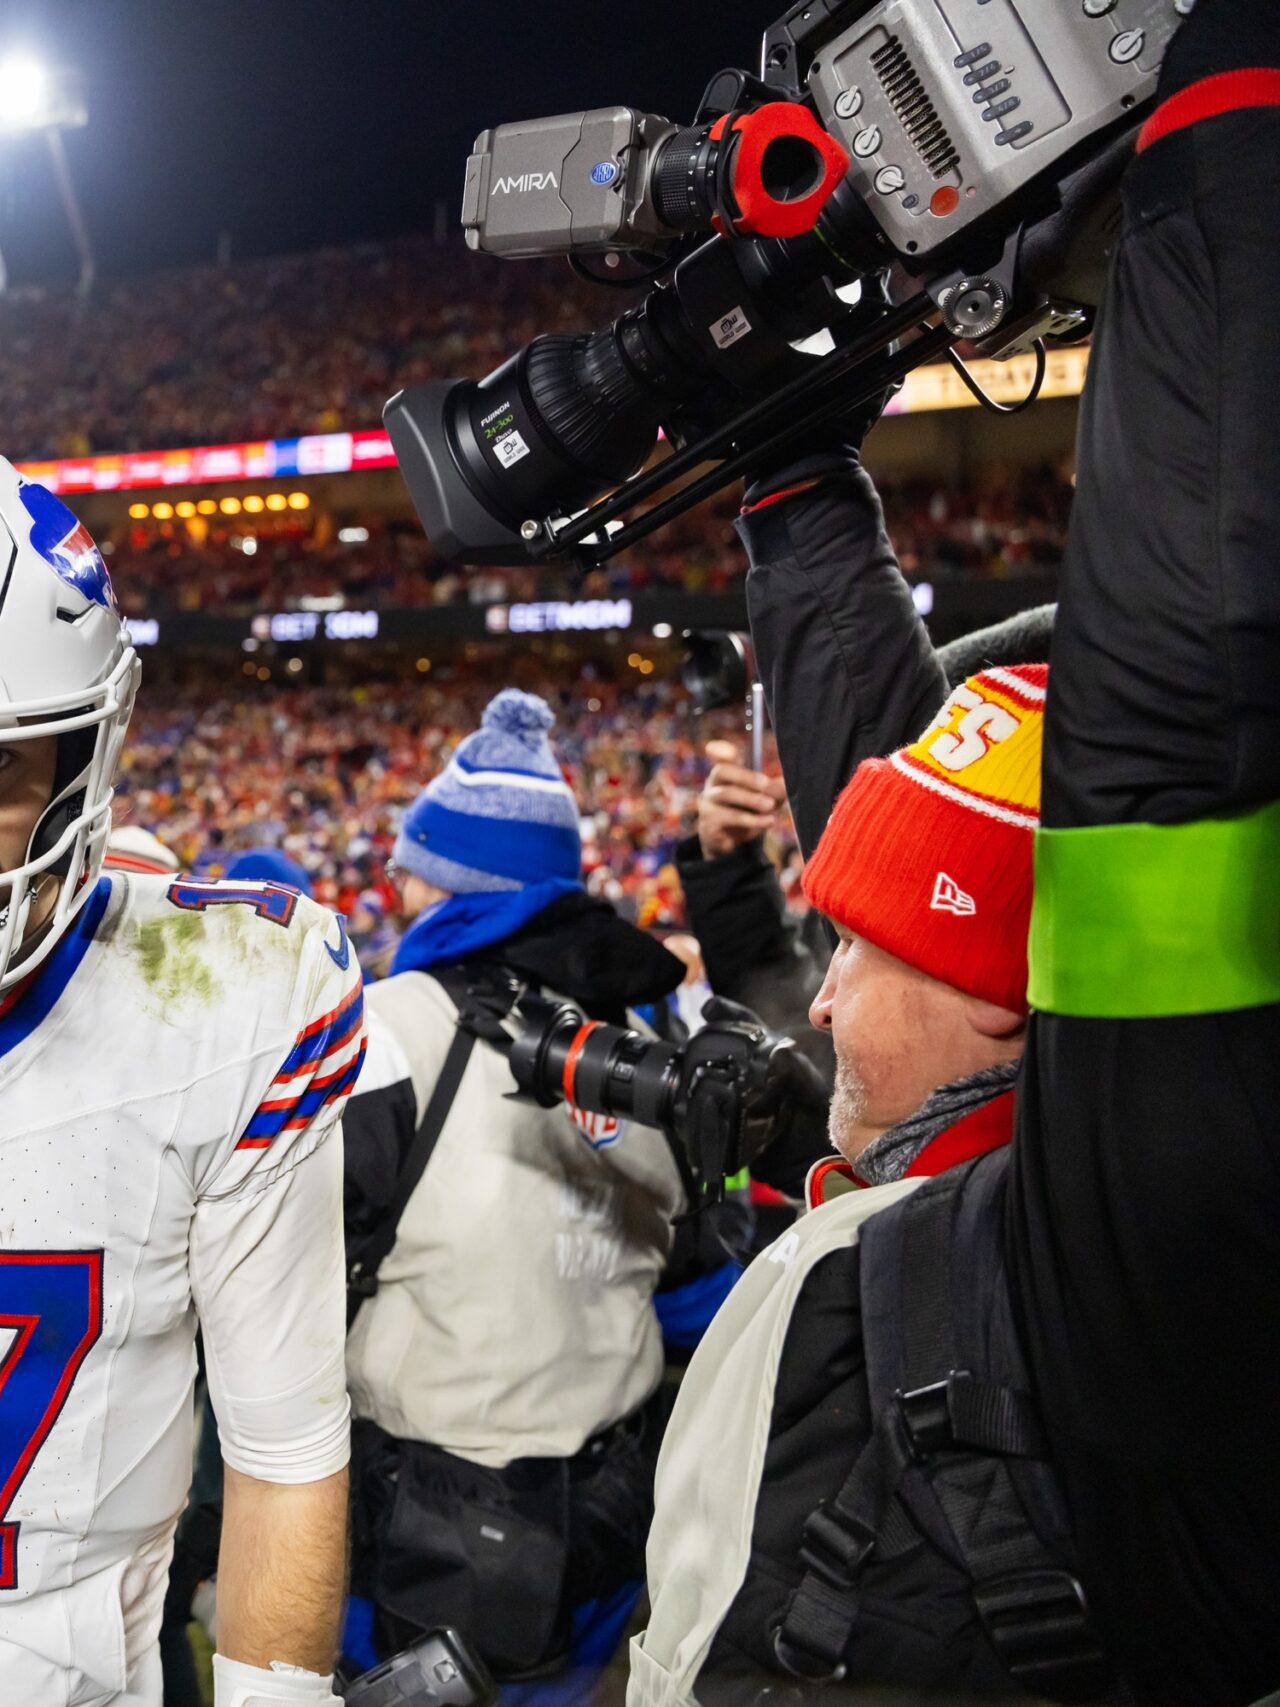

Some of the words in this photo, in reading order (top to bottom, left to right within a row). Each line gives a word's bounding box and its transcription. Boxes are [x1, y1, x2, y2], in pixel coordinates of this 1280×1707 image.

[491, 171, 558, 196] AMIRA
[481, 401, 510, 427] FUJINON
[484, 414, 514, 439] 24-300
